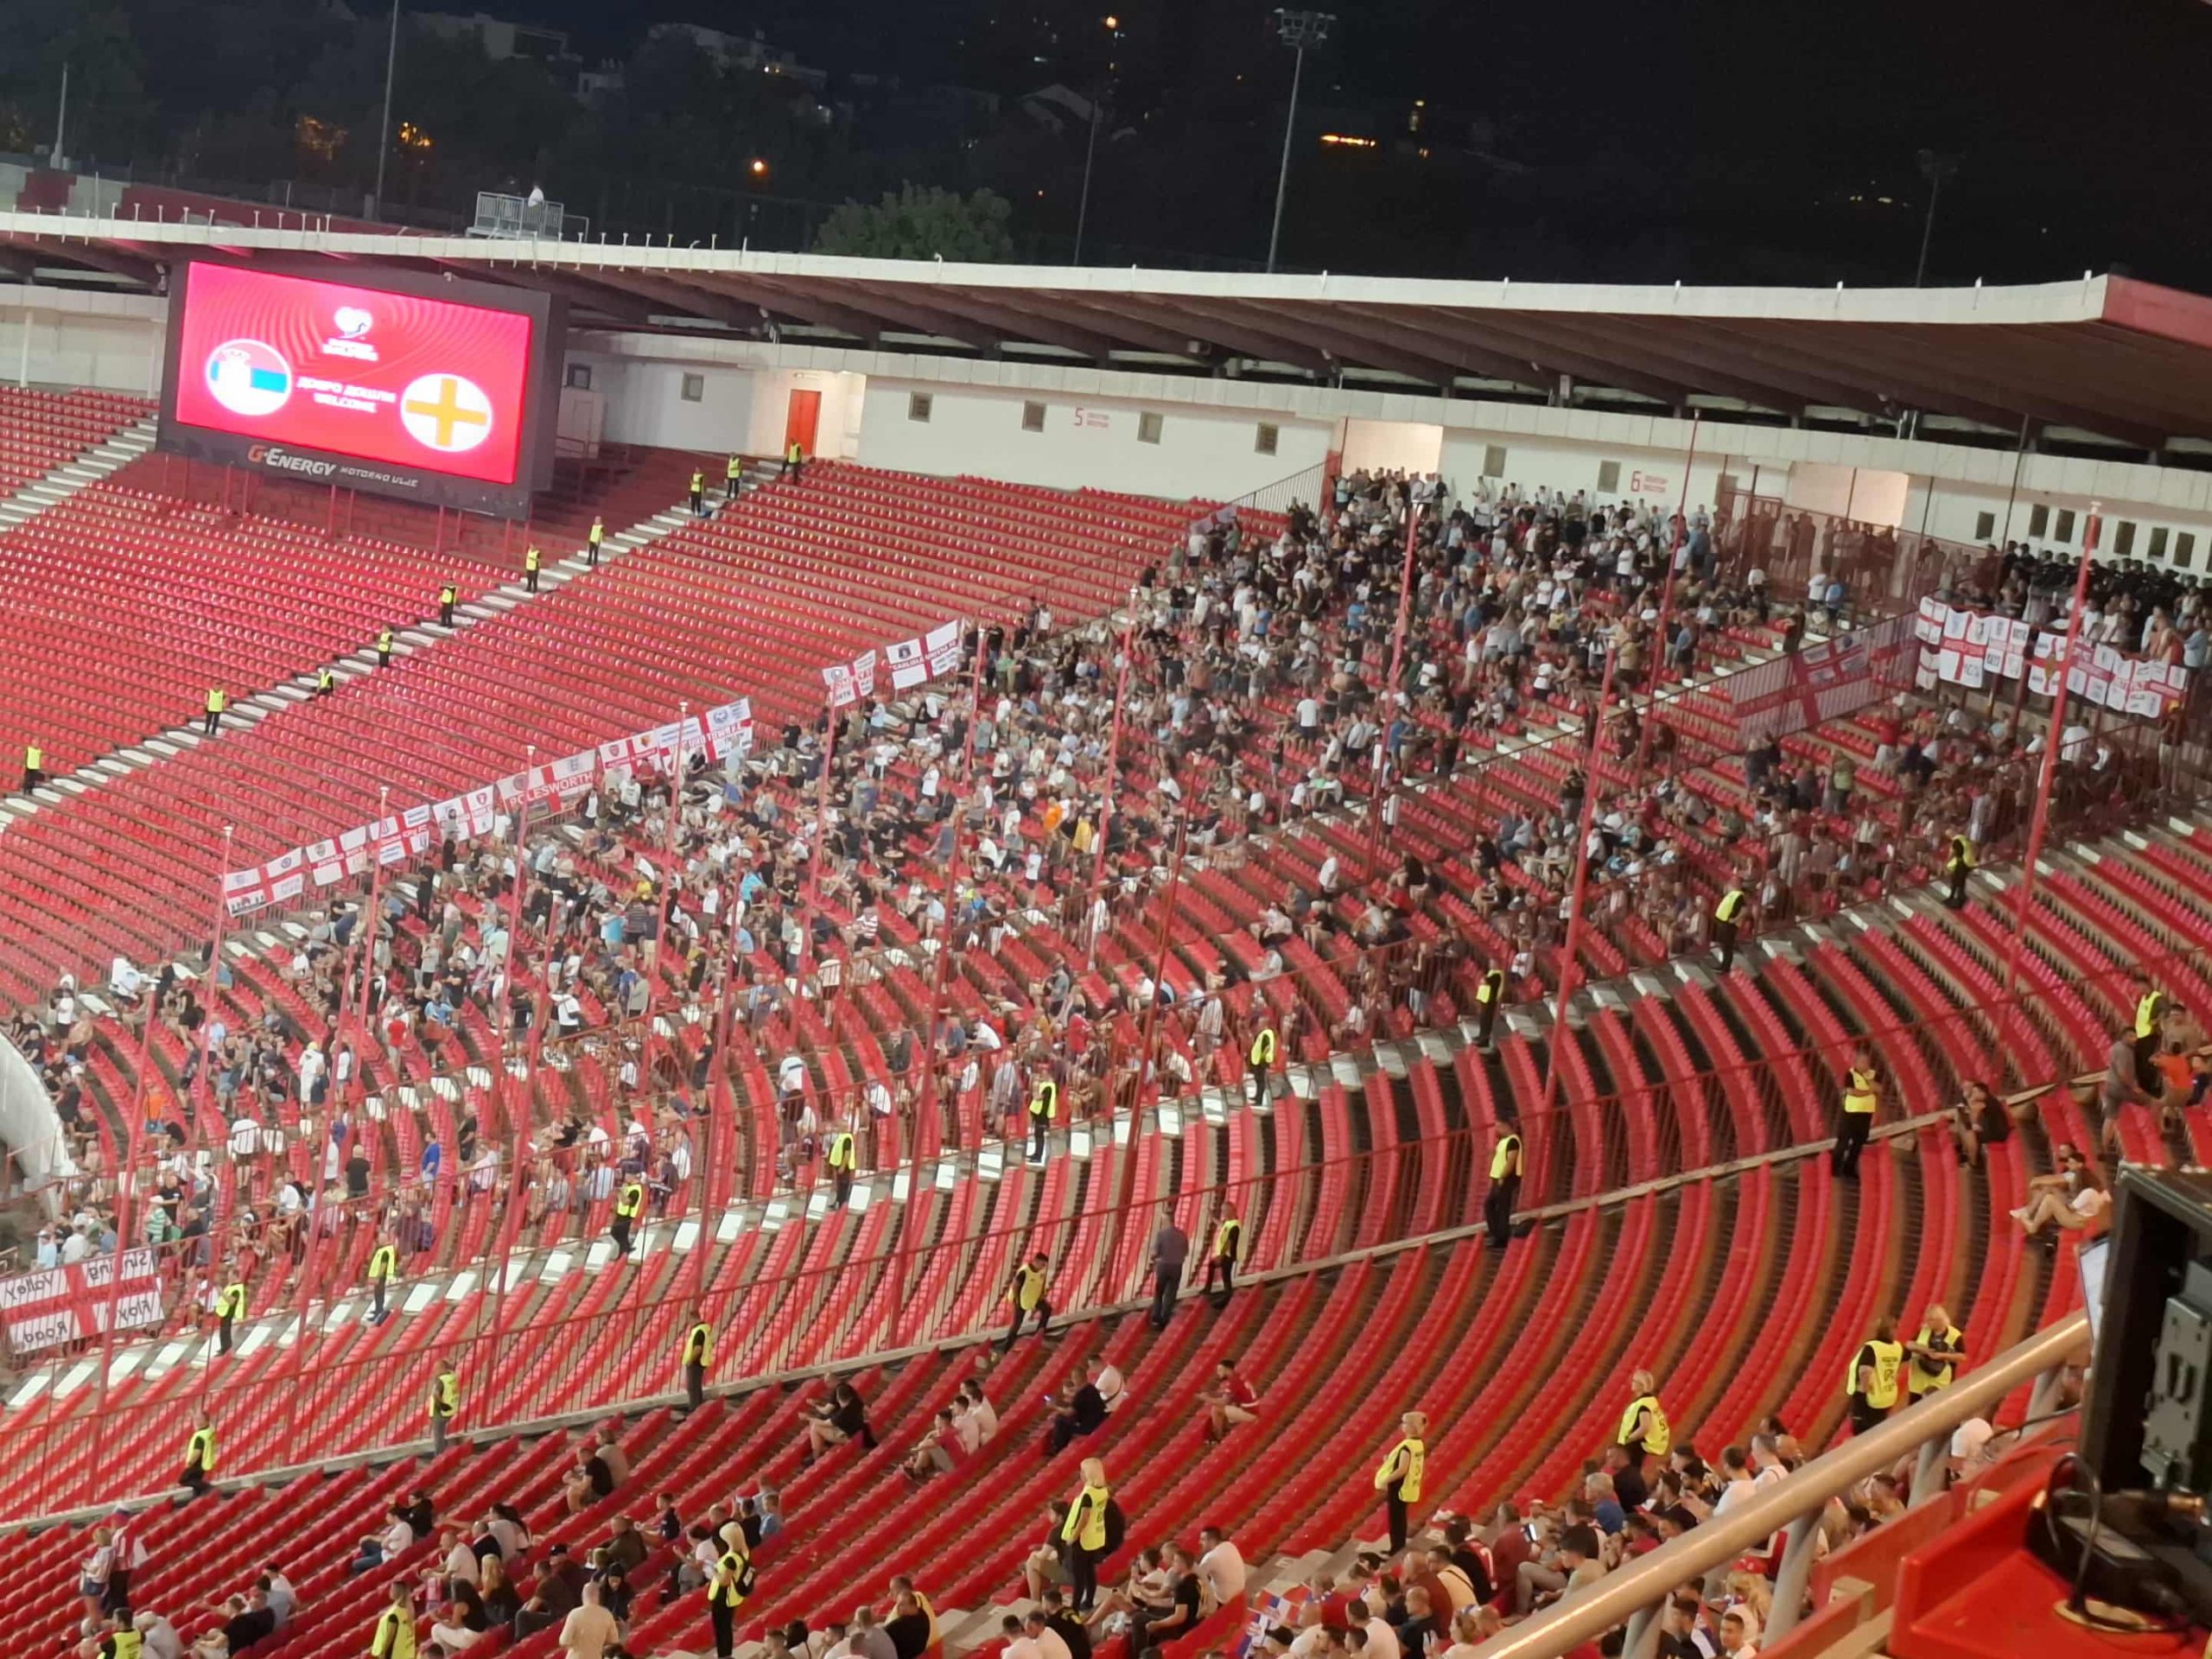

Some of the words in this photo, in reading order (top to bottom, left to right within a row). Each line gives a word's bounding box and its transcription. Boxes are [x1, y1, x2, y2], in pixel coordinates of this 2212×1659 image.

[1074, 407, 1084, 426] 5
[340, 466, 391, 482] MOTORNO
[391, 475, 418, 487] ULJE
[1630, 470, 1641, 492] 6
